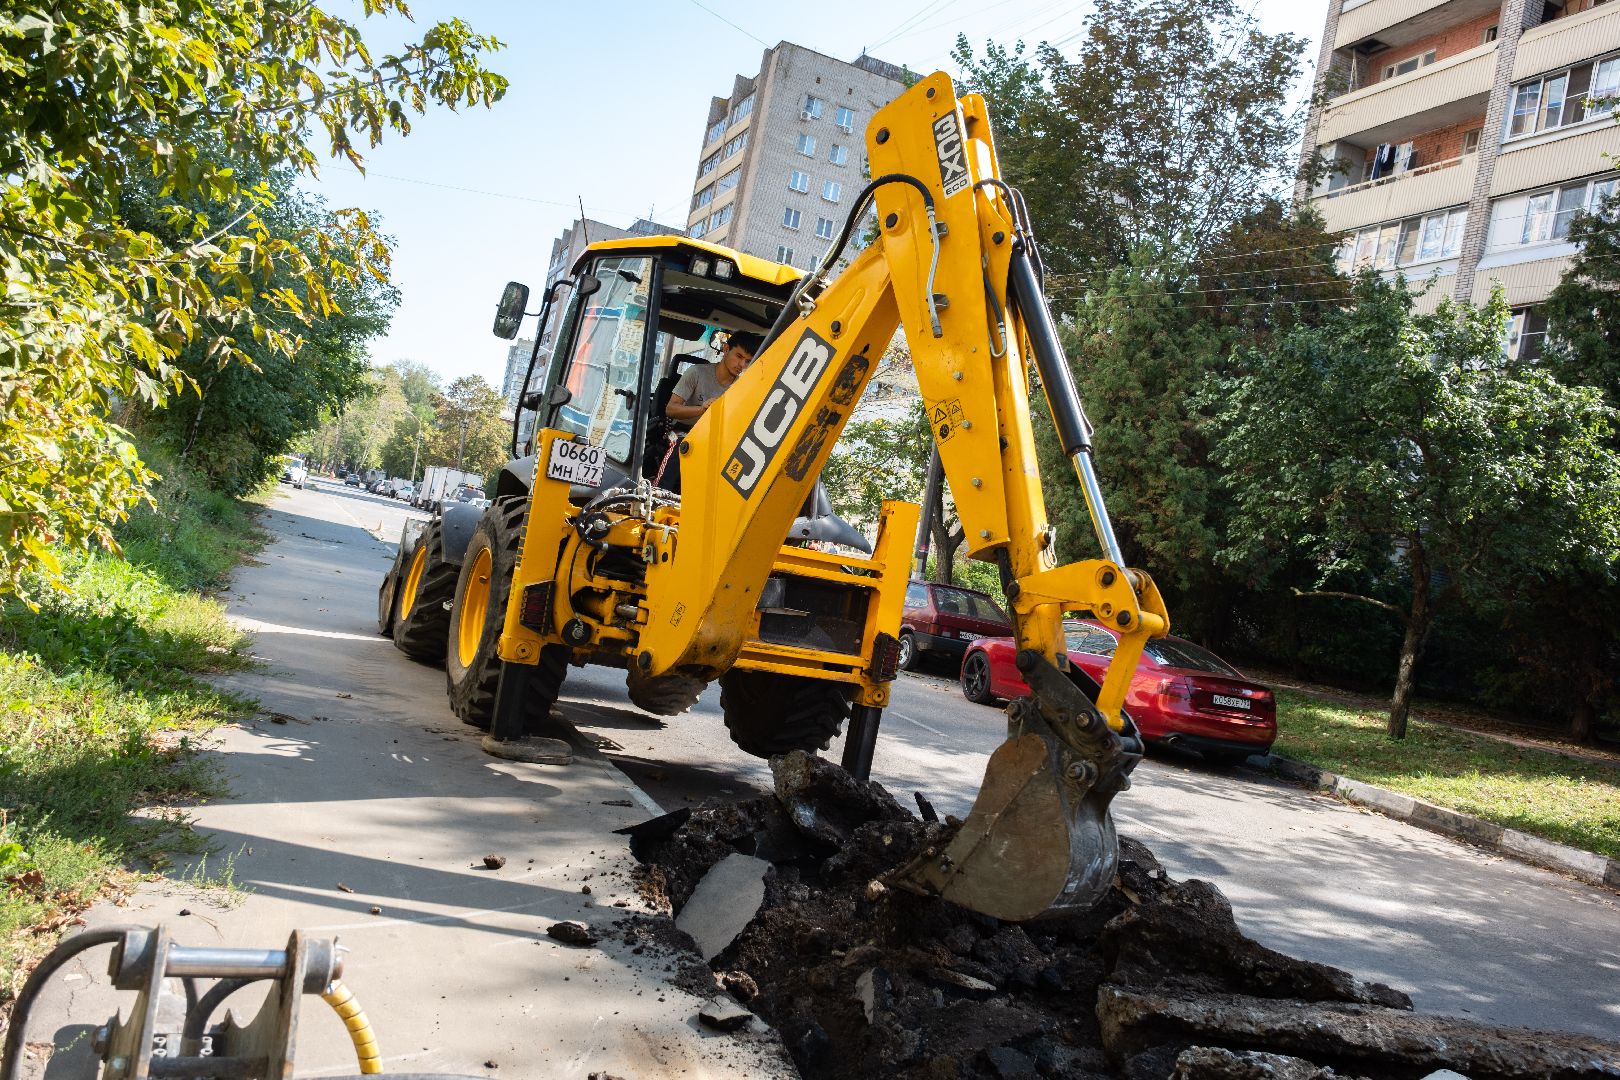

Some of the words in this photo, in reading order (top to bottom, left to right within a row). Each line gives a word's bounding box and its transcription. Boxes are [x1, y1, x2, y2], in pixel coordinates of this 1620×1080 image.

[934, 114, 965, 182] 3CX
[945, 178, 968, 196] ECO
[737, 337, 829, 491] JCB
[559, 442, 599, 465] 0660
[583, 465, 599, 480] 77
